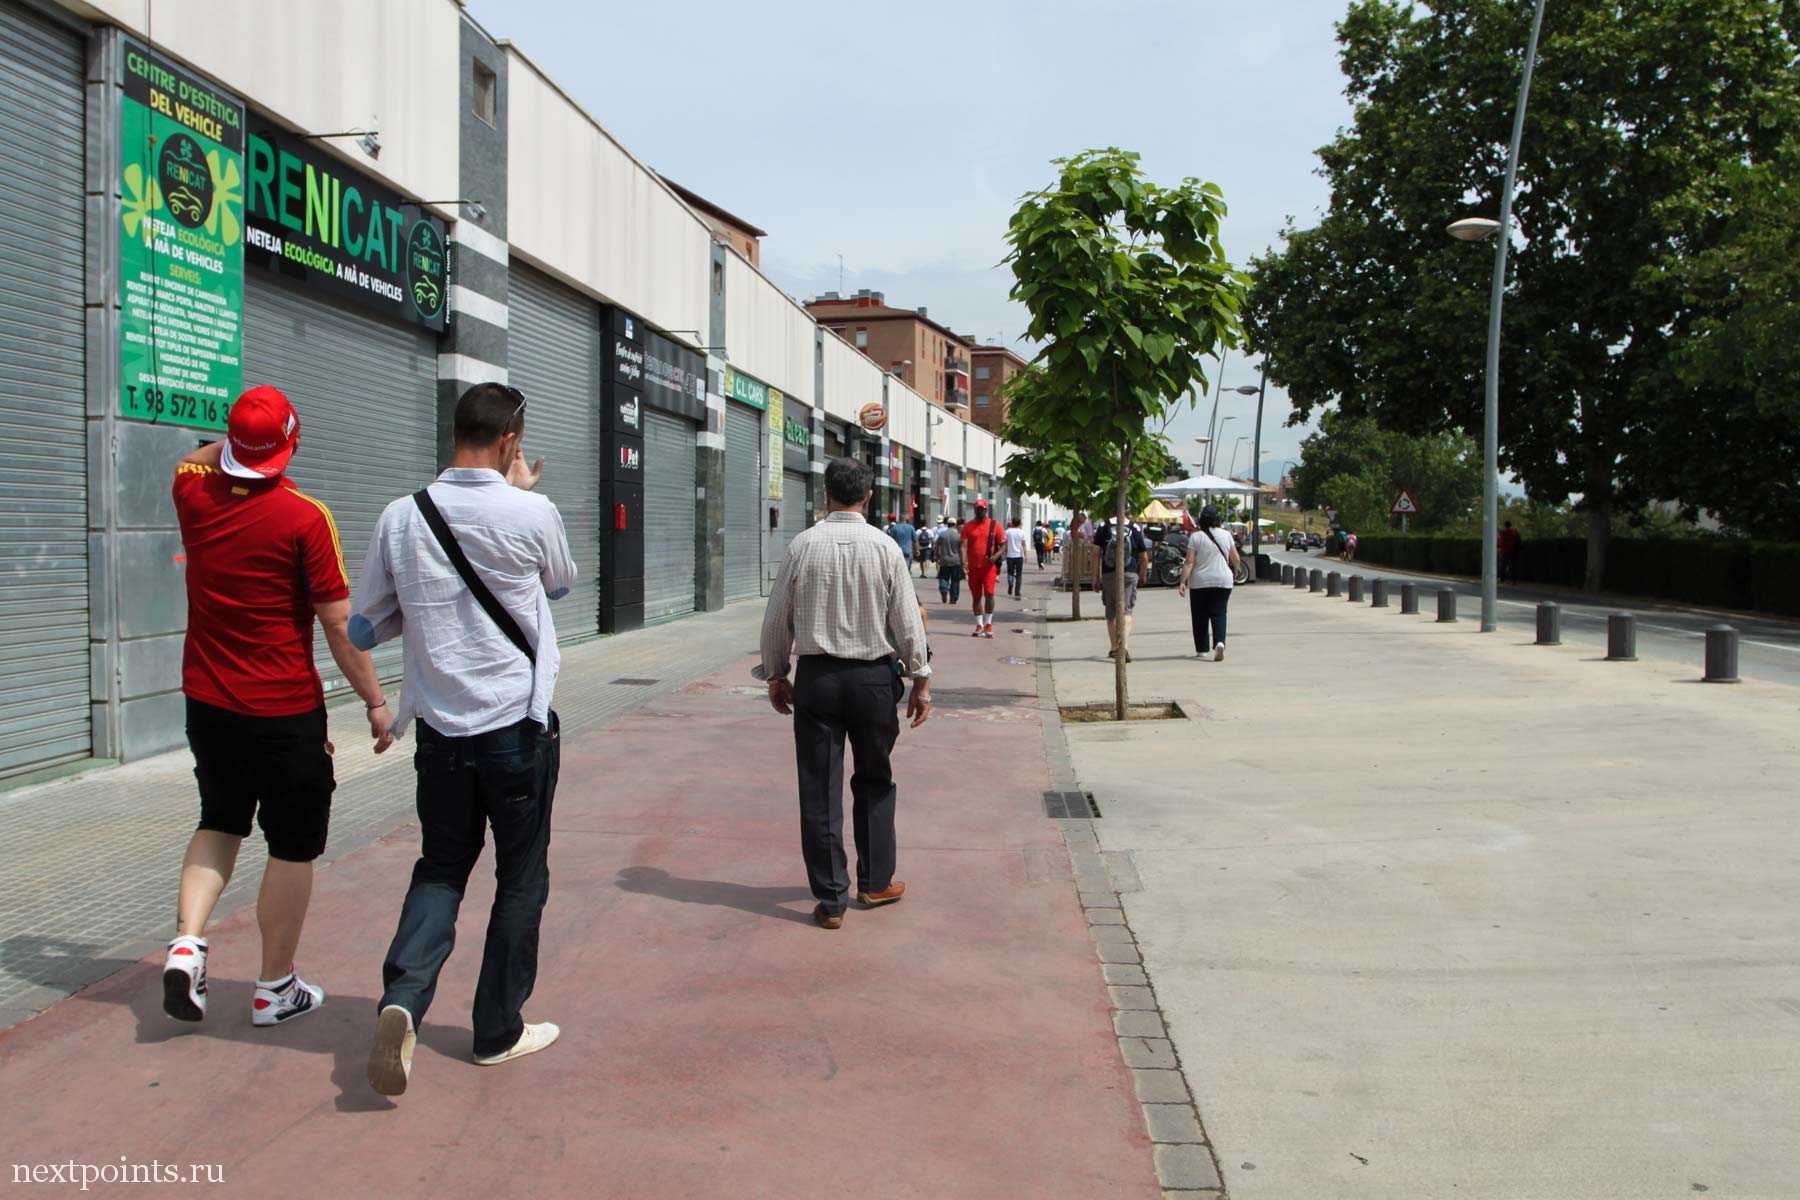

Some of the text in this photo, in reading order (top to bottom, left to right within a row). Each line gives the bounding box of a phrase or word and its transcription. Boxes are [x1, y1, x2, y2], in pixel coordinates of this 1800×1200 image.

[127, 52, 240, 129] CENTRE D'ESTÈTICA
[150, 88, 222, 142] DEL VEHICLE
[166, 161, 206, 191] RENICAT
[247, 131, 404, 273] RENICAT
[171, 244, 184, 260] DE
[185, 249, 224, 274] VEHICLES
[247, 225, 283, 256] NETEJA
[284, 241, 335, 276] ECOLÒGICA
[336, 263, 344, 279] A
[359, 272, 371, 289] DE
[370, 277, 403, 302] VEHICLES
[413, 252, 441, 276] RENICAT
[126, 384, 138, 410] T.
[170, 393, 197, 419] 572
[201, 399, 217, 422] 16
[222, 402, 231, 424] 3
